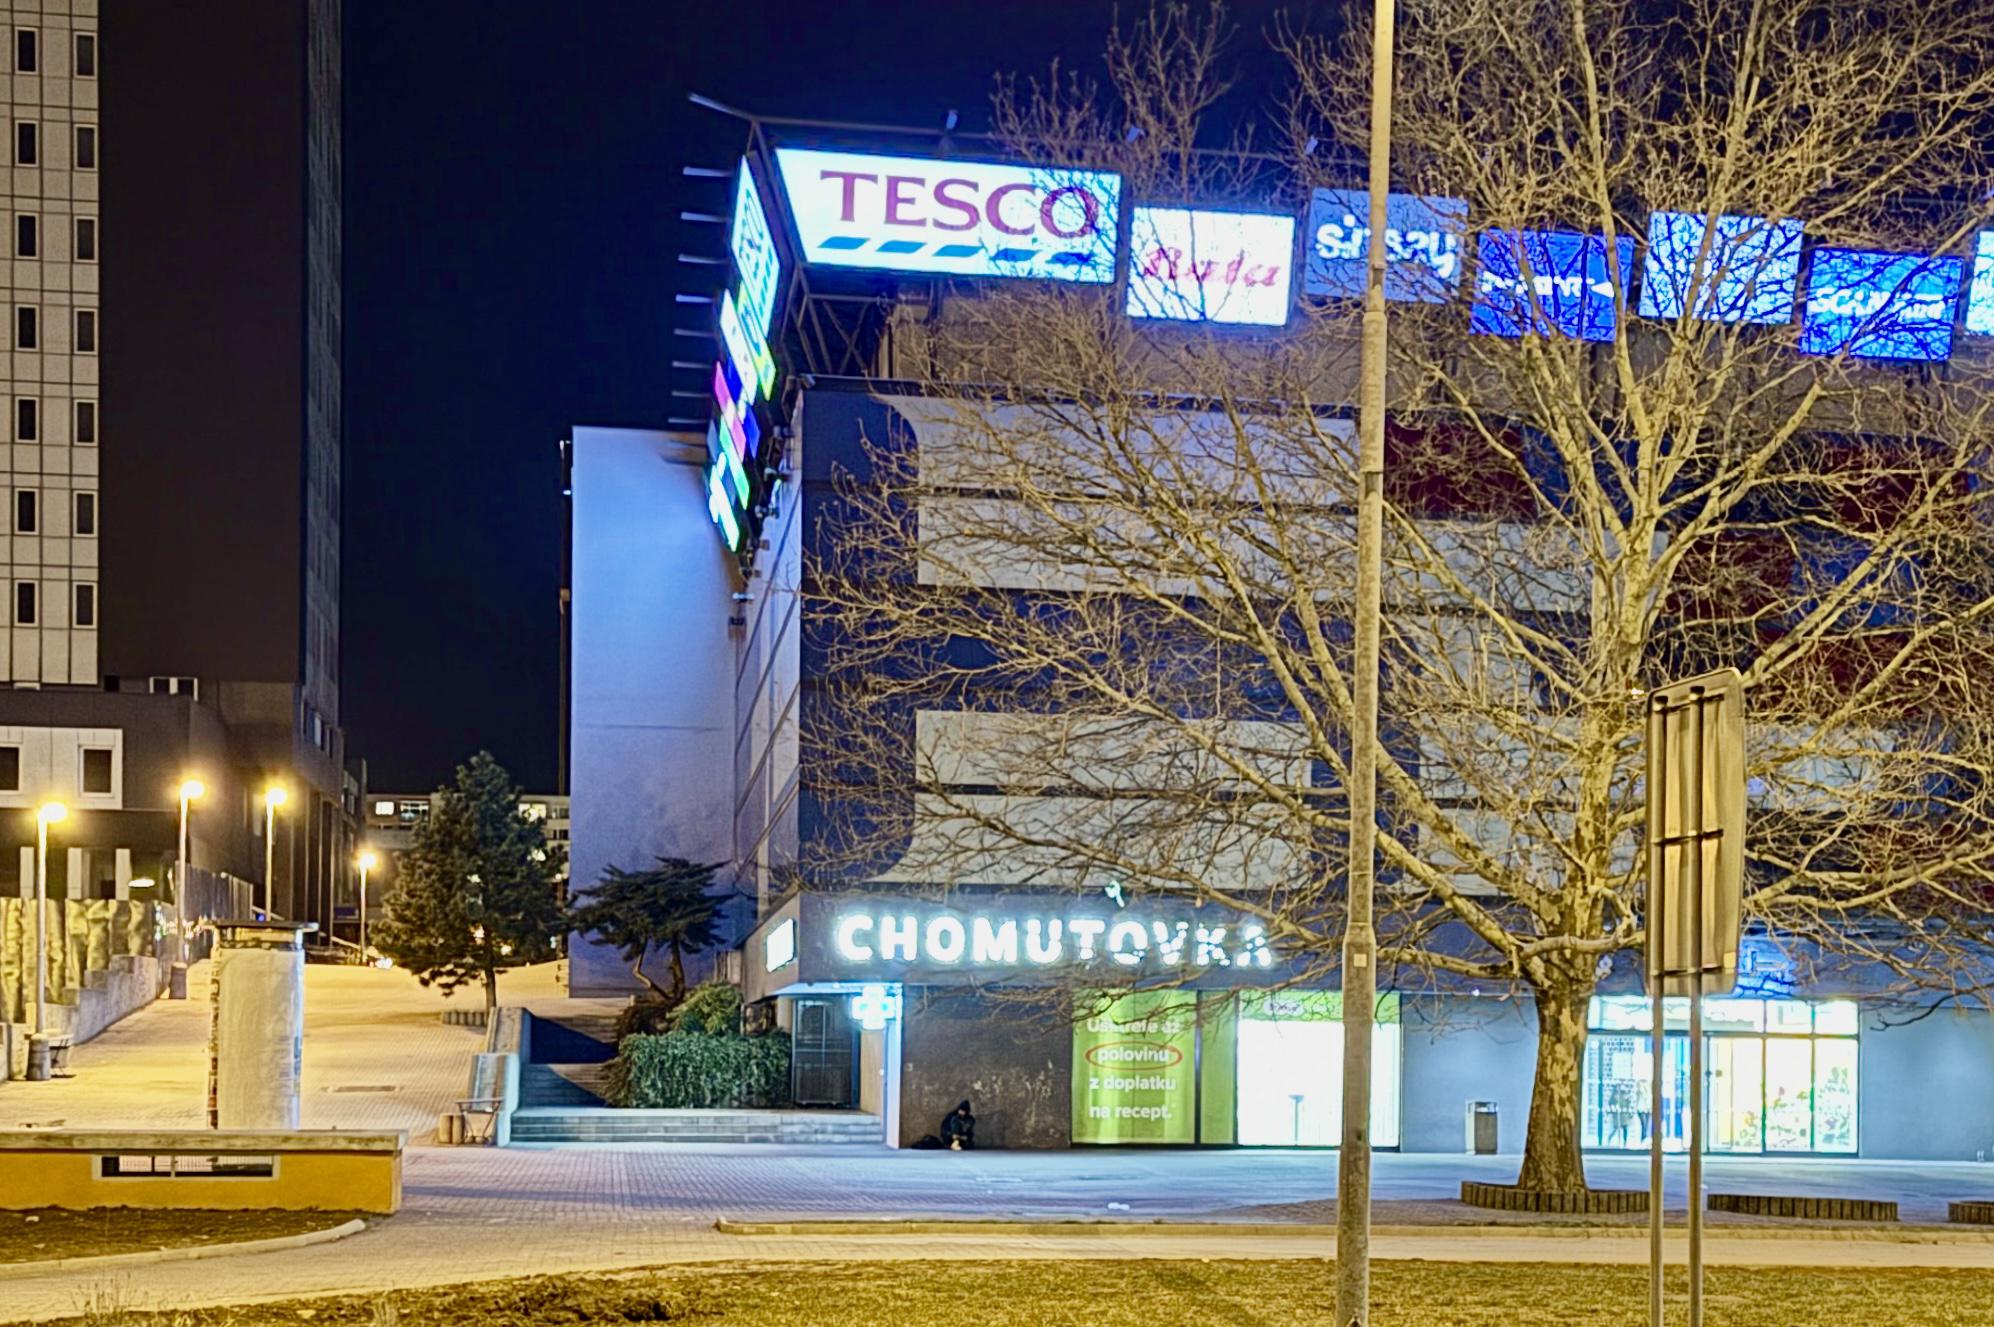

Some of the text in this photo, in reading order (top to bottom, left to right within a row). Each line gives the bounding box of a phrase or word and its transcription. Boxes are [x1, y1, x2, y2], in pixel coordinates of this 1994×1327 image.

[819, 169, 1100, 239] TESCO
[836, 914, 1273, 967] CHOMUTOVKA
[1097, 1045, 1169, 1064] polovinu
[1088, 1074, 1176, 1093] z doplatku
[1089, 1105, 1111, 1119] na
